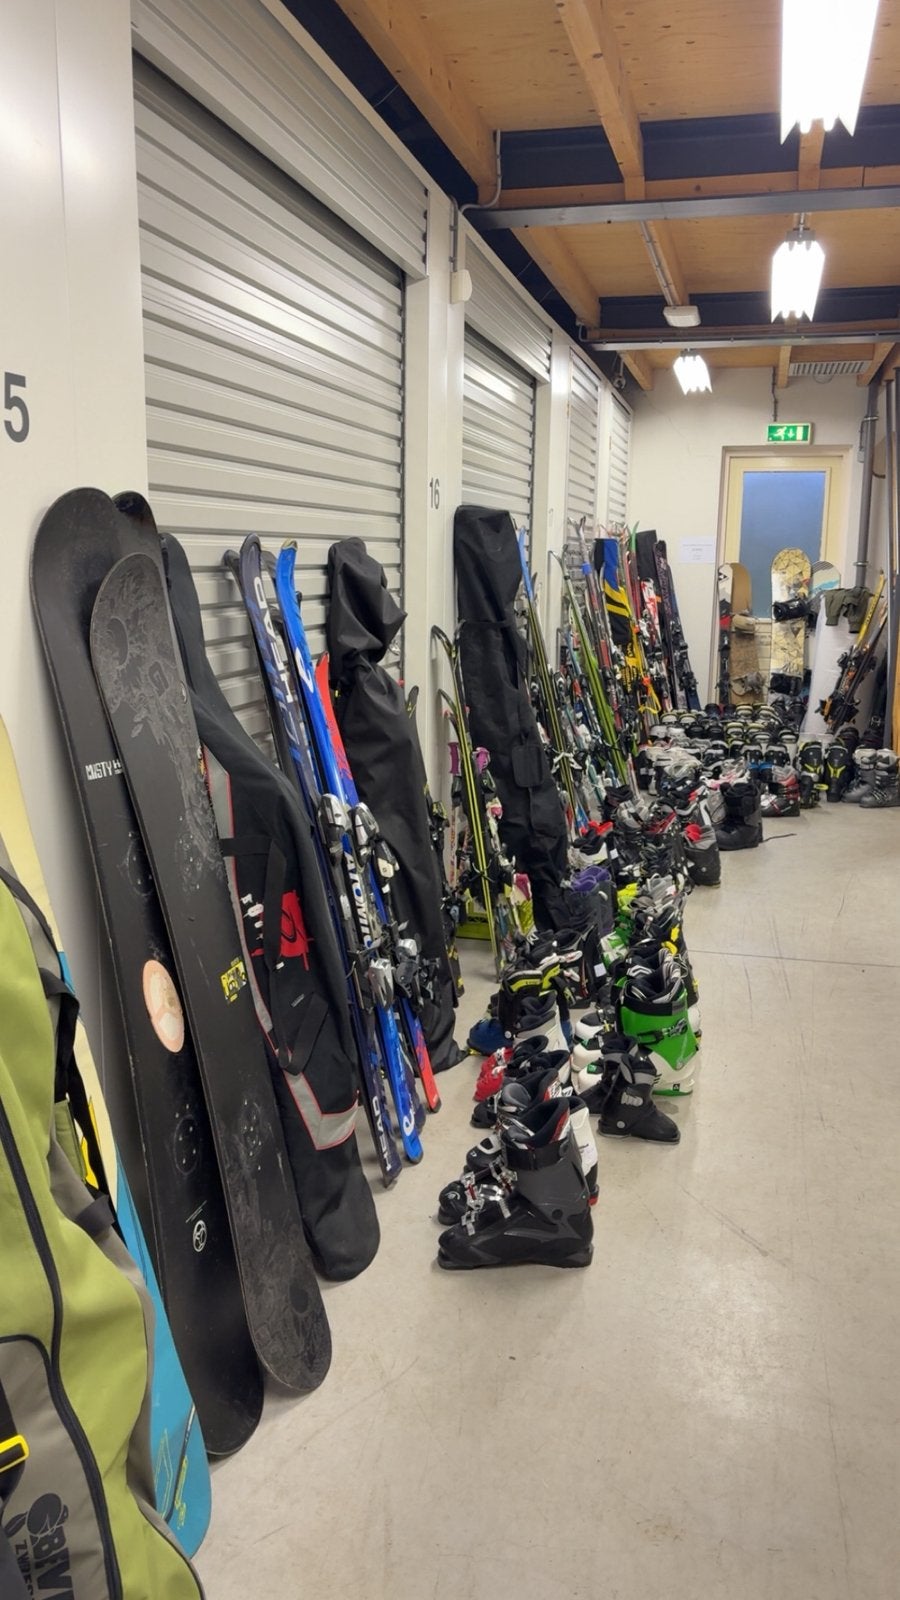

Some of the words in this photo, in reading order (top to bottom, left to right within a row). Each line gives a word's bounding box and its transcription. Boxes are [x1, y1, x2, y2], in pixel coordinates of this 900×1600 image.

[3, 371, 30, 443] 5
[429, 477, 440, 510] 16
[253, 576, 294, 703] HEAD
[343, 850, 373, 950] ATOMIC
[372, 1095, 392, 1171] HEAD
